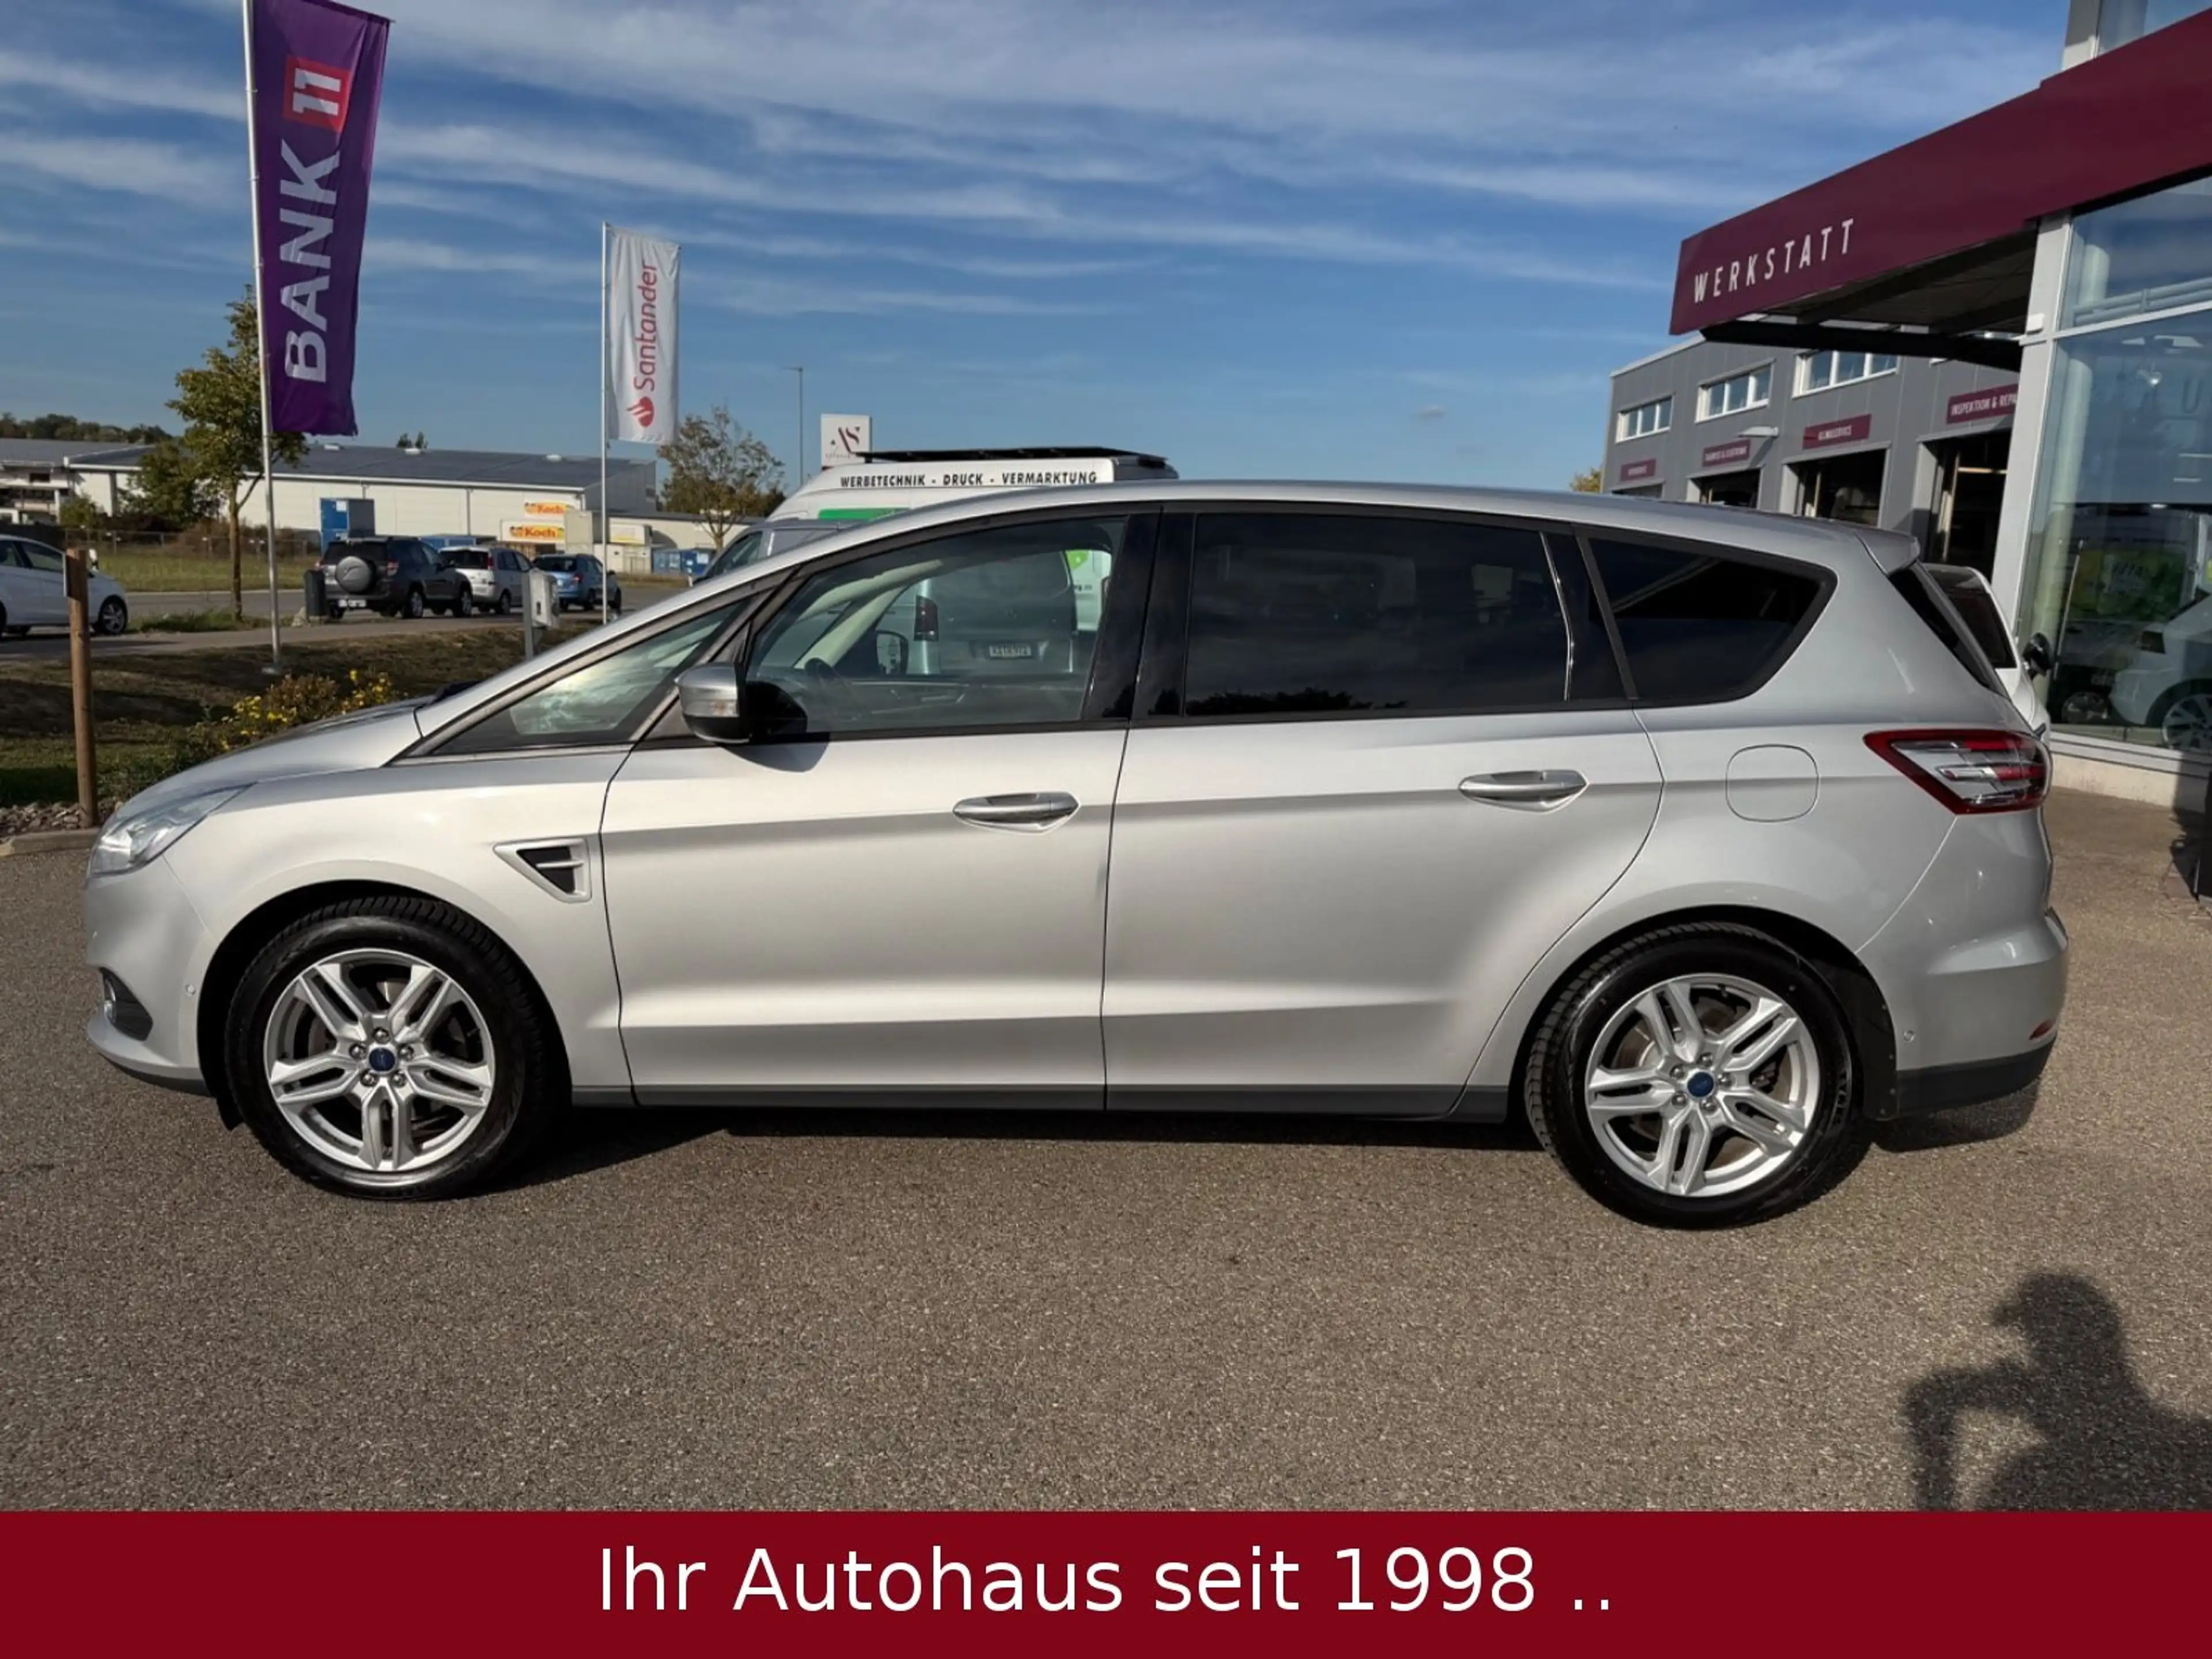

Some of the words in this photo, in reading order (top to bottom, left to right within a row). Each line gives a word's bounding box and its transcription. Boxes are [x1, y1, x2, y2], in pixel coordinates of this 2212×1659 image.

[292, 67, 342, 116] 11
[279, 140, 341, 383] BANK
[1694, 218, 1854, 304] WERKSTATT
[634, 260, 657, 392] Santander
[1951, 397, 1990, 416] INSPEKTION
[840, 475, 926, 487] WERBETECHNIK
[943, 474, 983, 486] DRUCK
[1002, 471, 1097, 485] VERMARKTUNG
[537, 502, 566, 514] Koch
[525, 527, 556, 538] Koch
